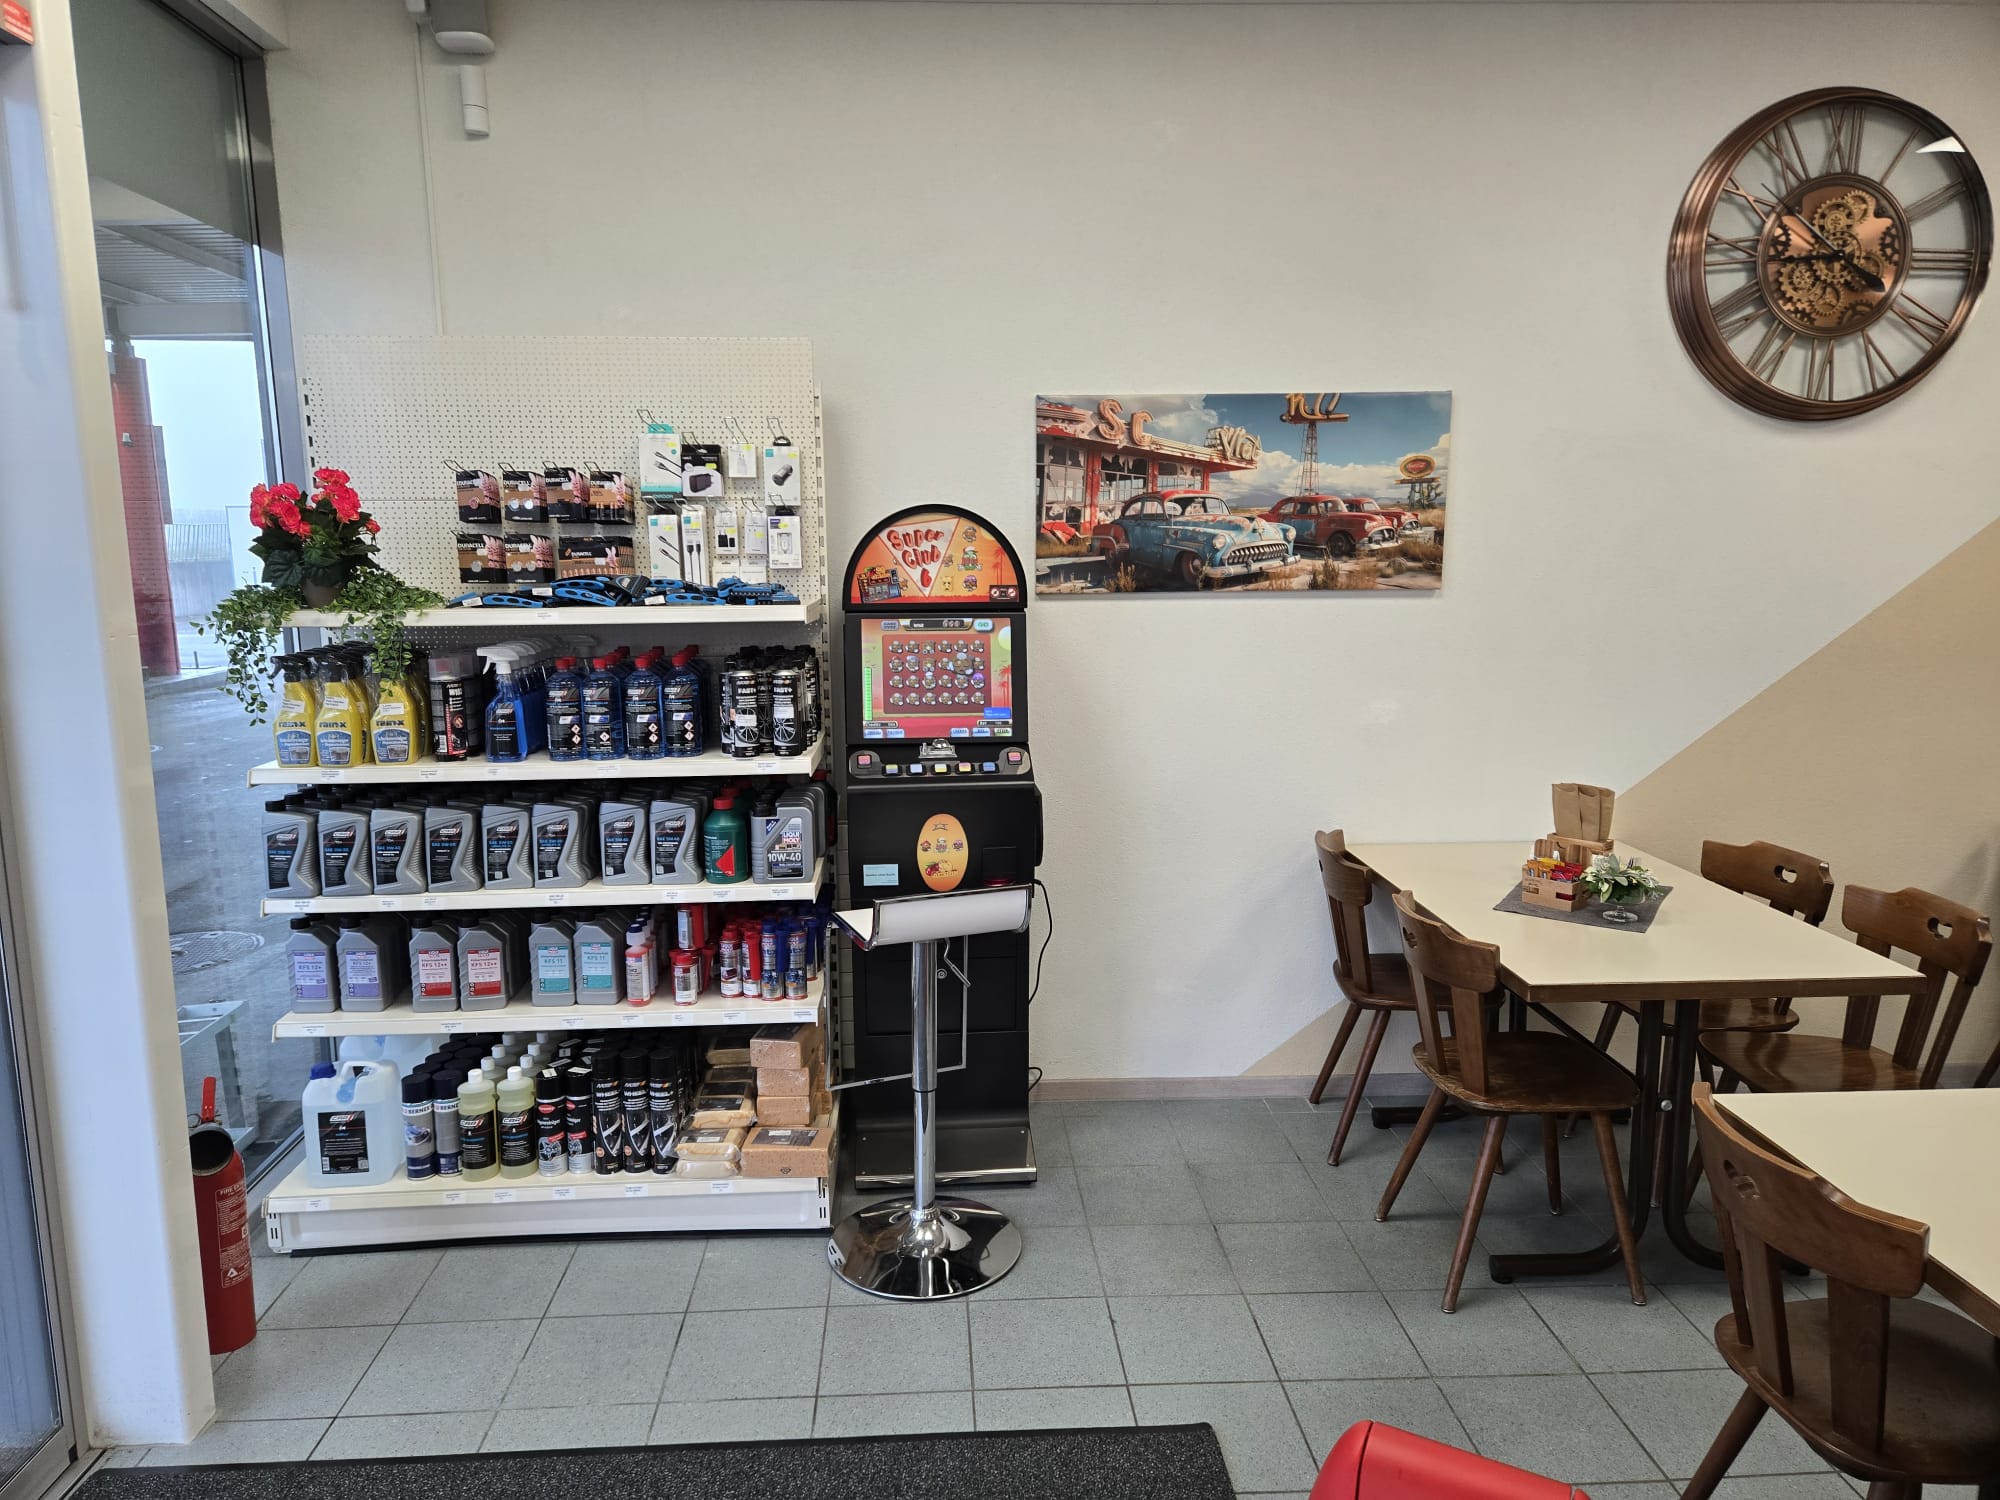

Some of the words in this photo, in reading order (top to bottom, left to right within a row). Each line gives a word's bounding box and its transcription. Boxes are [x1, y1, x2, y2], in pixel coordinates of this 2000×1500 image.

[886, 529, 945, 551] Super
[902, 544, 942, 569] Club
[920, 567, 932, 588] 6
[767, 852, 802, 862] 10W-40
